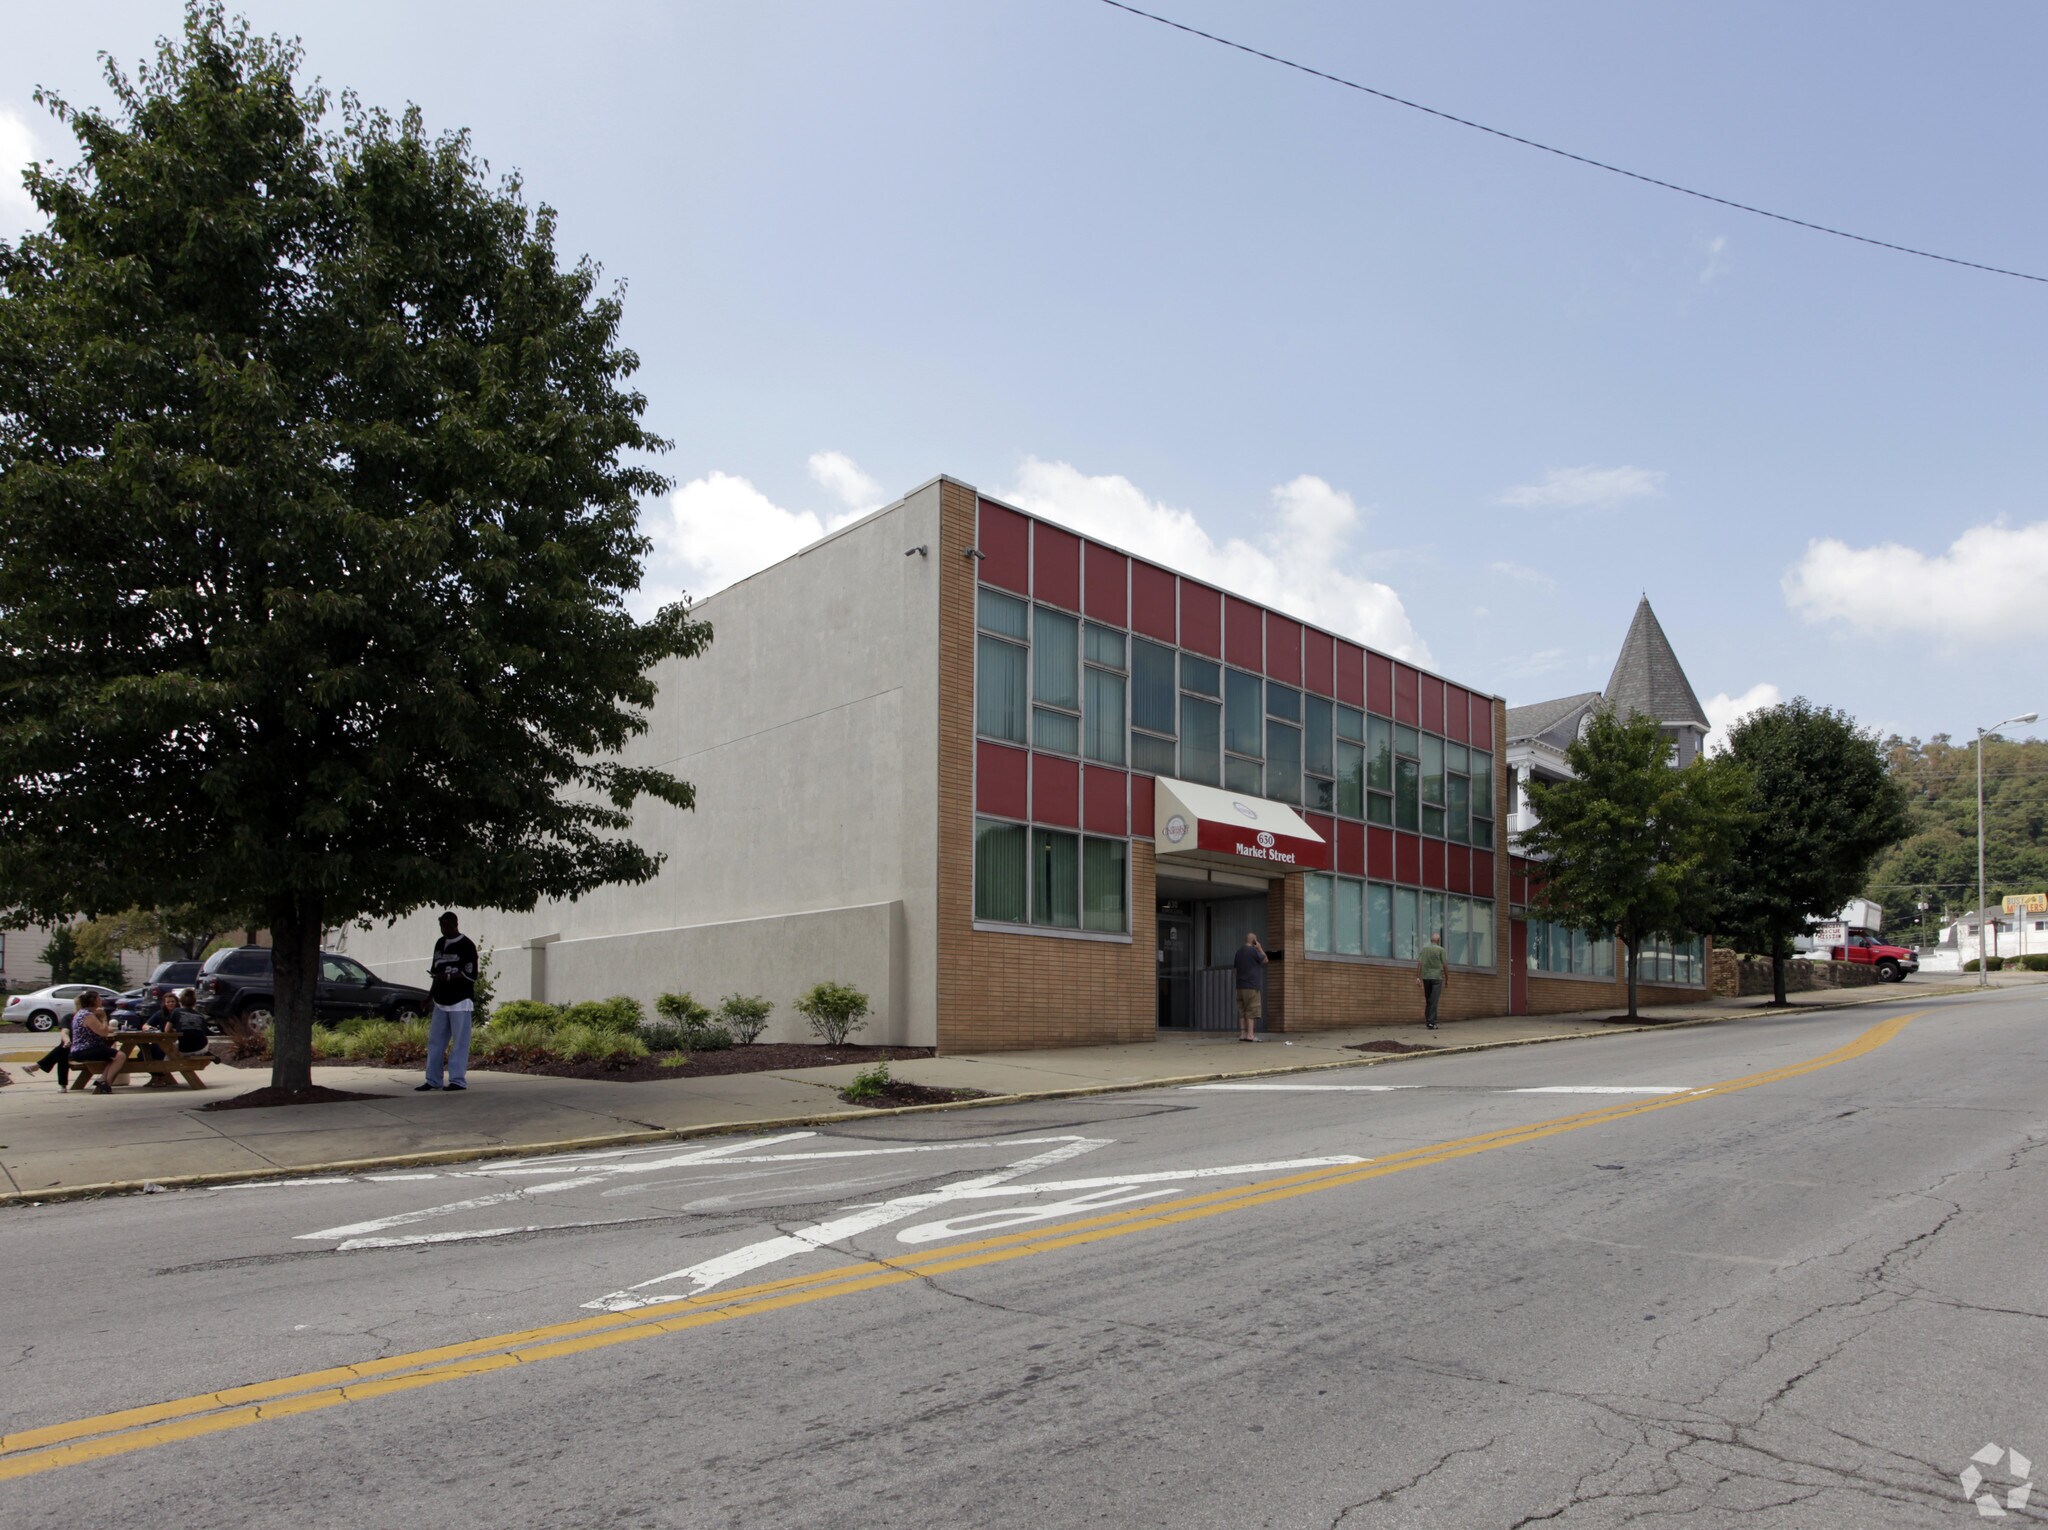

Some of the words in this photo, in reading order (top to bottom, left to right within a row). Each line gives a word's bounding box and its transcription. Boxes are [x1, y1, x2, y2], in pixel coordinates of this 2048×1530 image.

[1258, 834, 1274, 845] 630
[1236, 843, 1267, 859] Market
[1269, 848, 1295, 864] Street
[2007, 904, 2044, 913] MLERS
